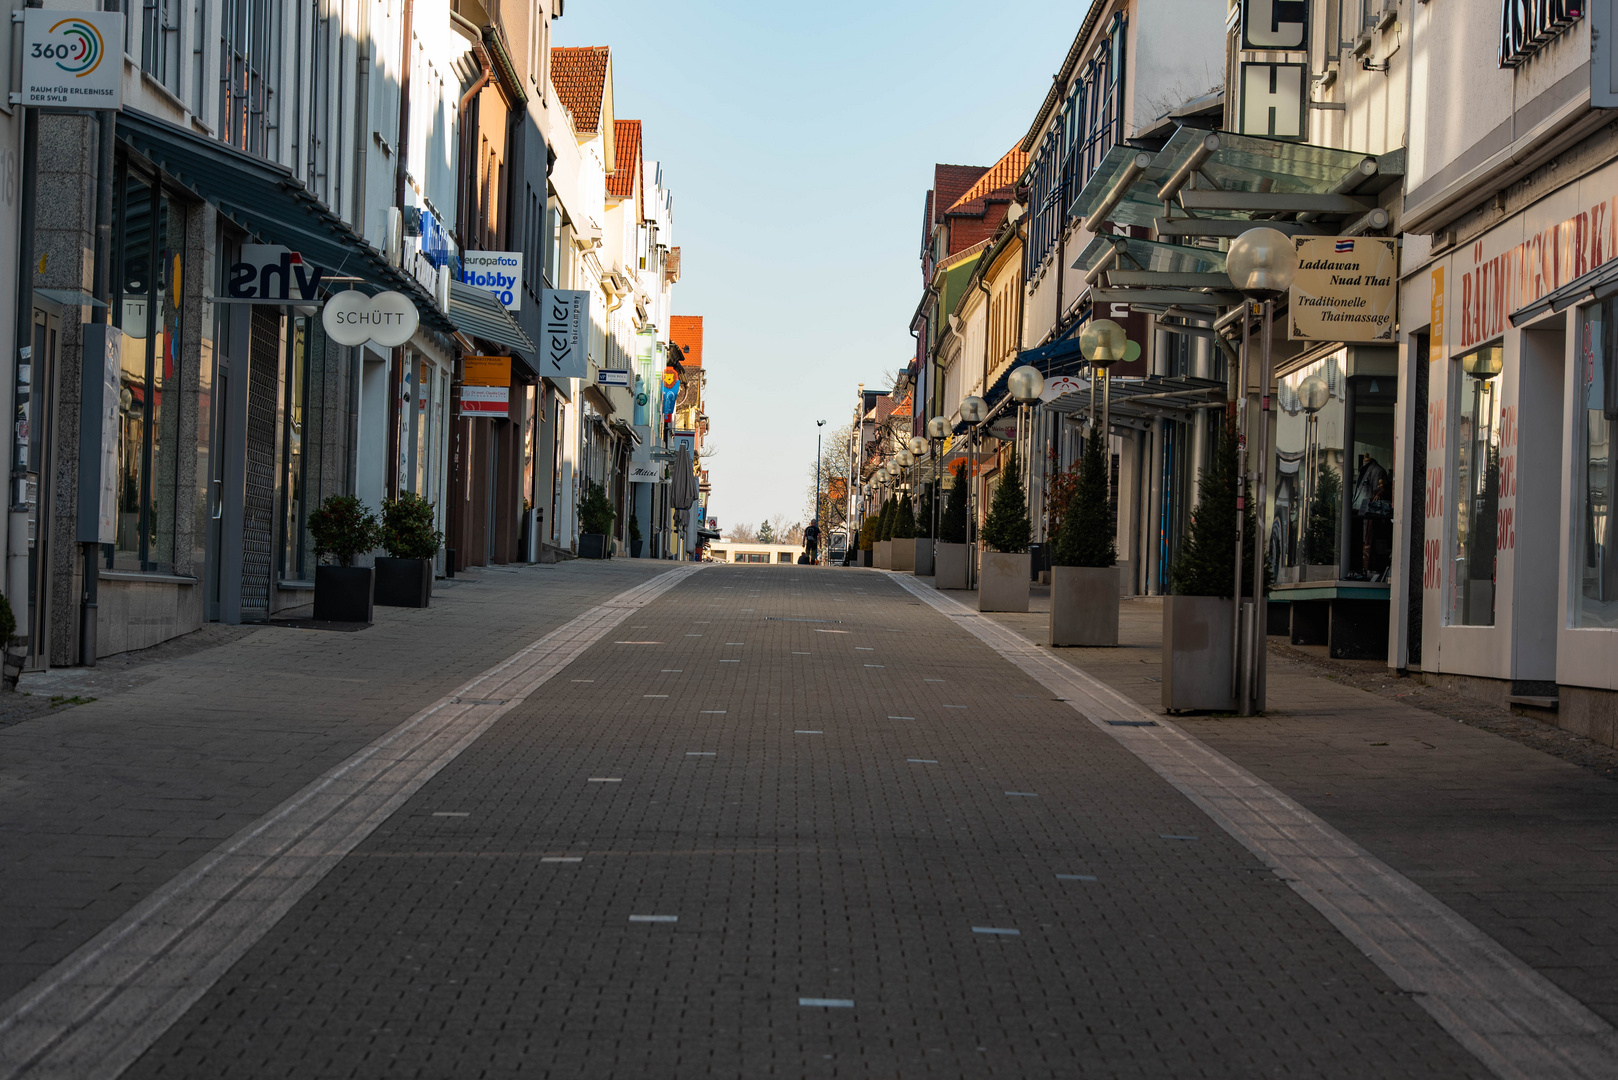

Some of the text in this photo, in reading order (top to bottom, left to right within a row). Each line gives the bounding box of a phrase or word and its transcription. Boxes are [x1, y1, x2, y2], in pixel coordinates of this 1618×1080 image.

[31, 43, 77, 59] 360°
[30, 86, 114, 96] RAUM FÜR ERLEBNISSE
[464, 256, 518, 267] europafoto
[1298, 259, 1360, 271] Laddawan
[463, 270, 517, 290] Hobby
[1329, 275, 1391, 287] Nuad Thai
[1298, 296, 1367, 308] Traditionelle
[336, 310, 404, 325] SCHÜTT
[573, 295, 581, 329] company
[1321, 310, 1390, 326] Thaimassage
[1500, 403, 1518, 449] 70%
[1498, 454, 1517, 499] 50%
[1426, 467, 1444, 519] 50%
[1497, 507, 1515, 551] 30%
[1424, 538, 1442, 590] 30%
